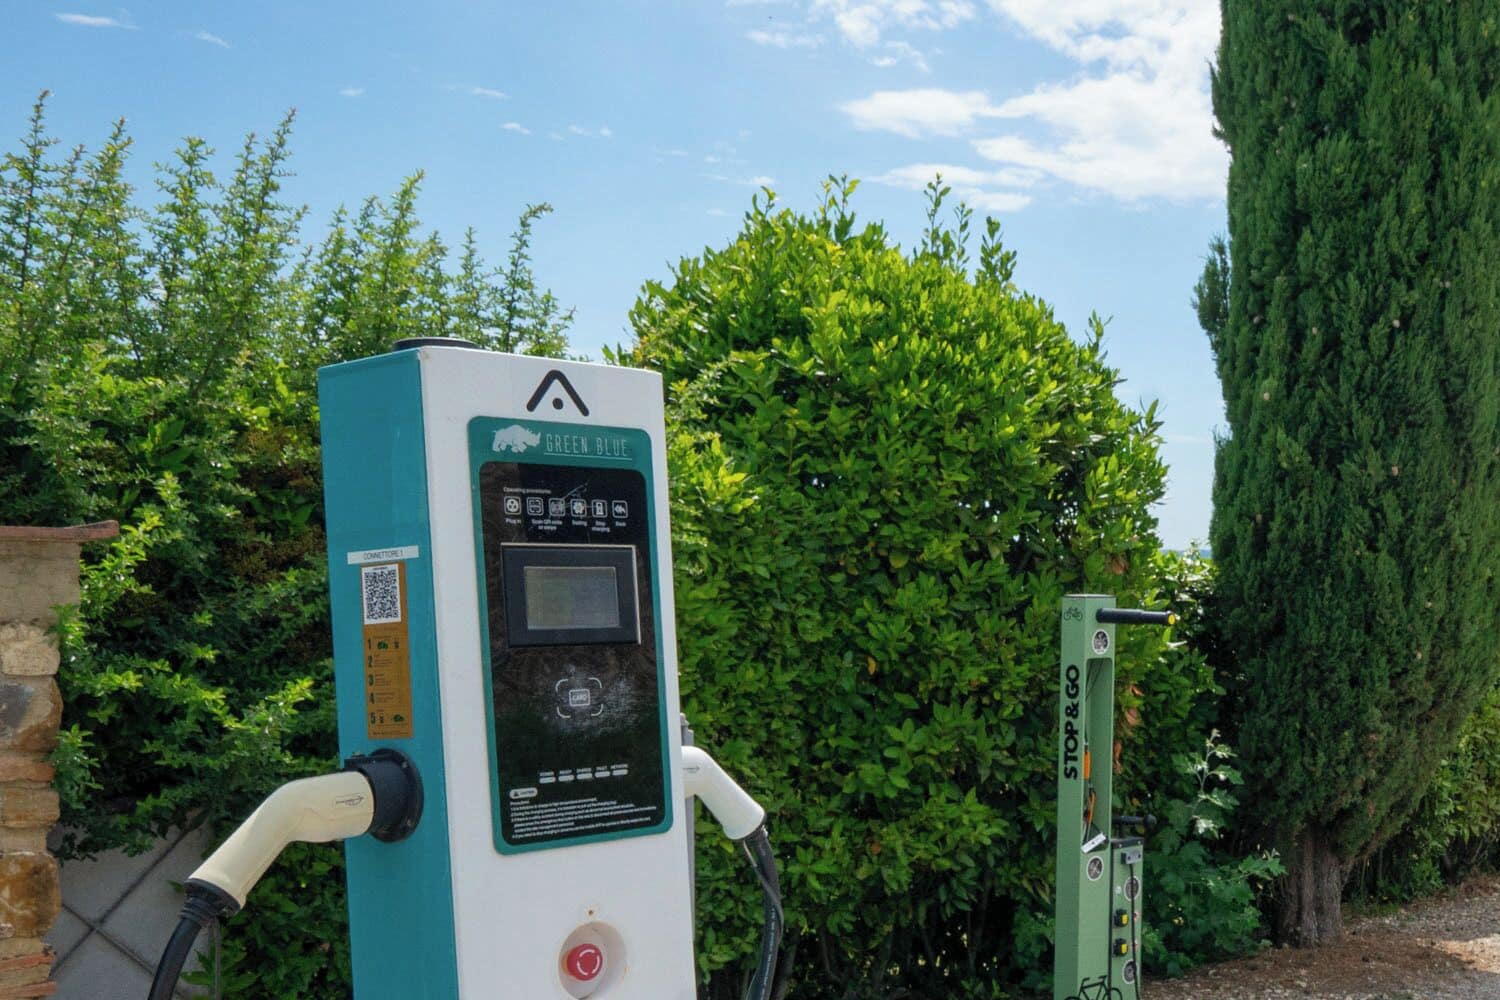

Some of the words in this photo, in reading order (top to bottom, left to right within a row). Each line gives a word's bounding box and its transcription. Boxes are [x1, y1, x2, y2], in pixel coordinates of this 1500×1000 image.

[546, 433, 588, 454] GREEN
[596, 437, 628, 457] BLUE
[1065, 664, 1080, 699] GO
[1065, 702, 1079, 720] &
[1064, 720, 1079, 780] STOP
